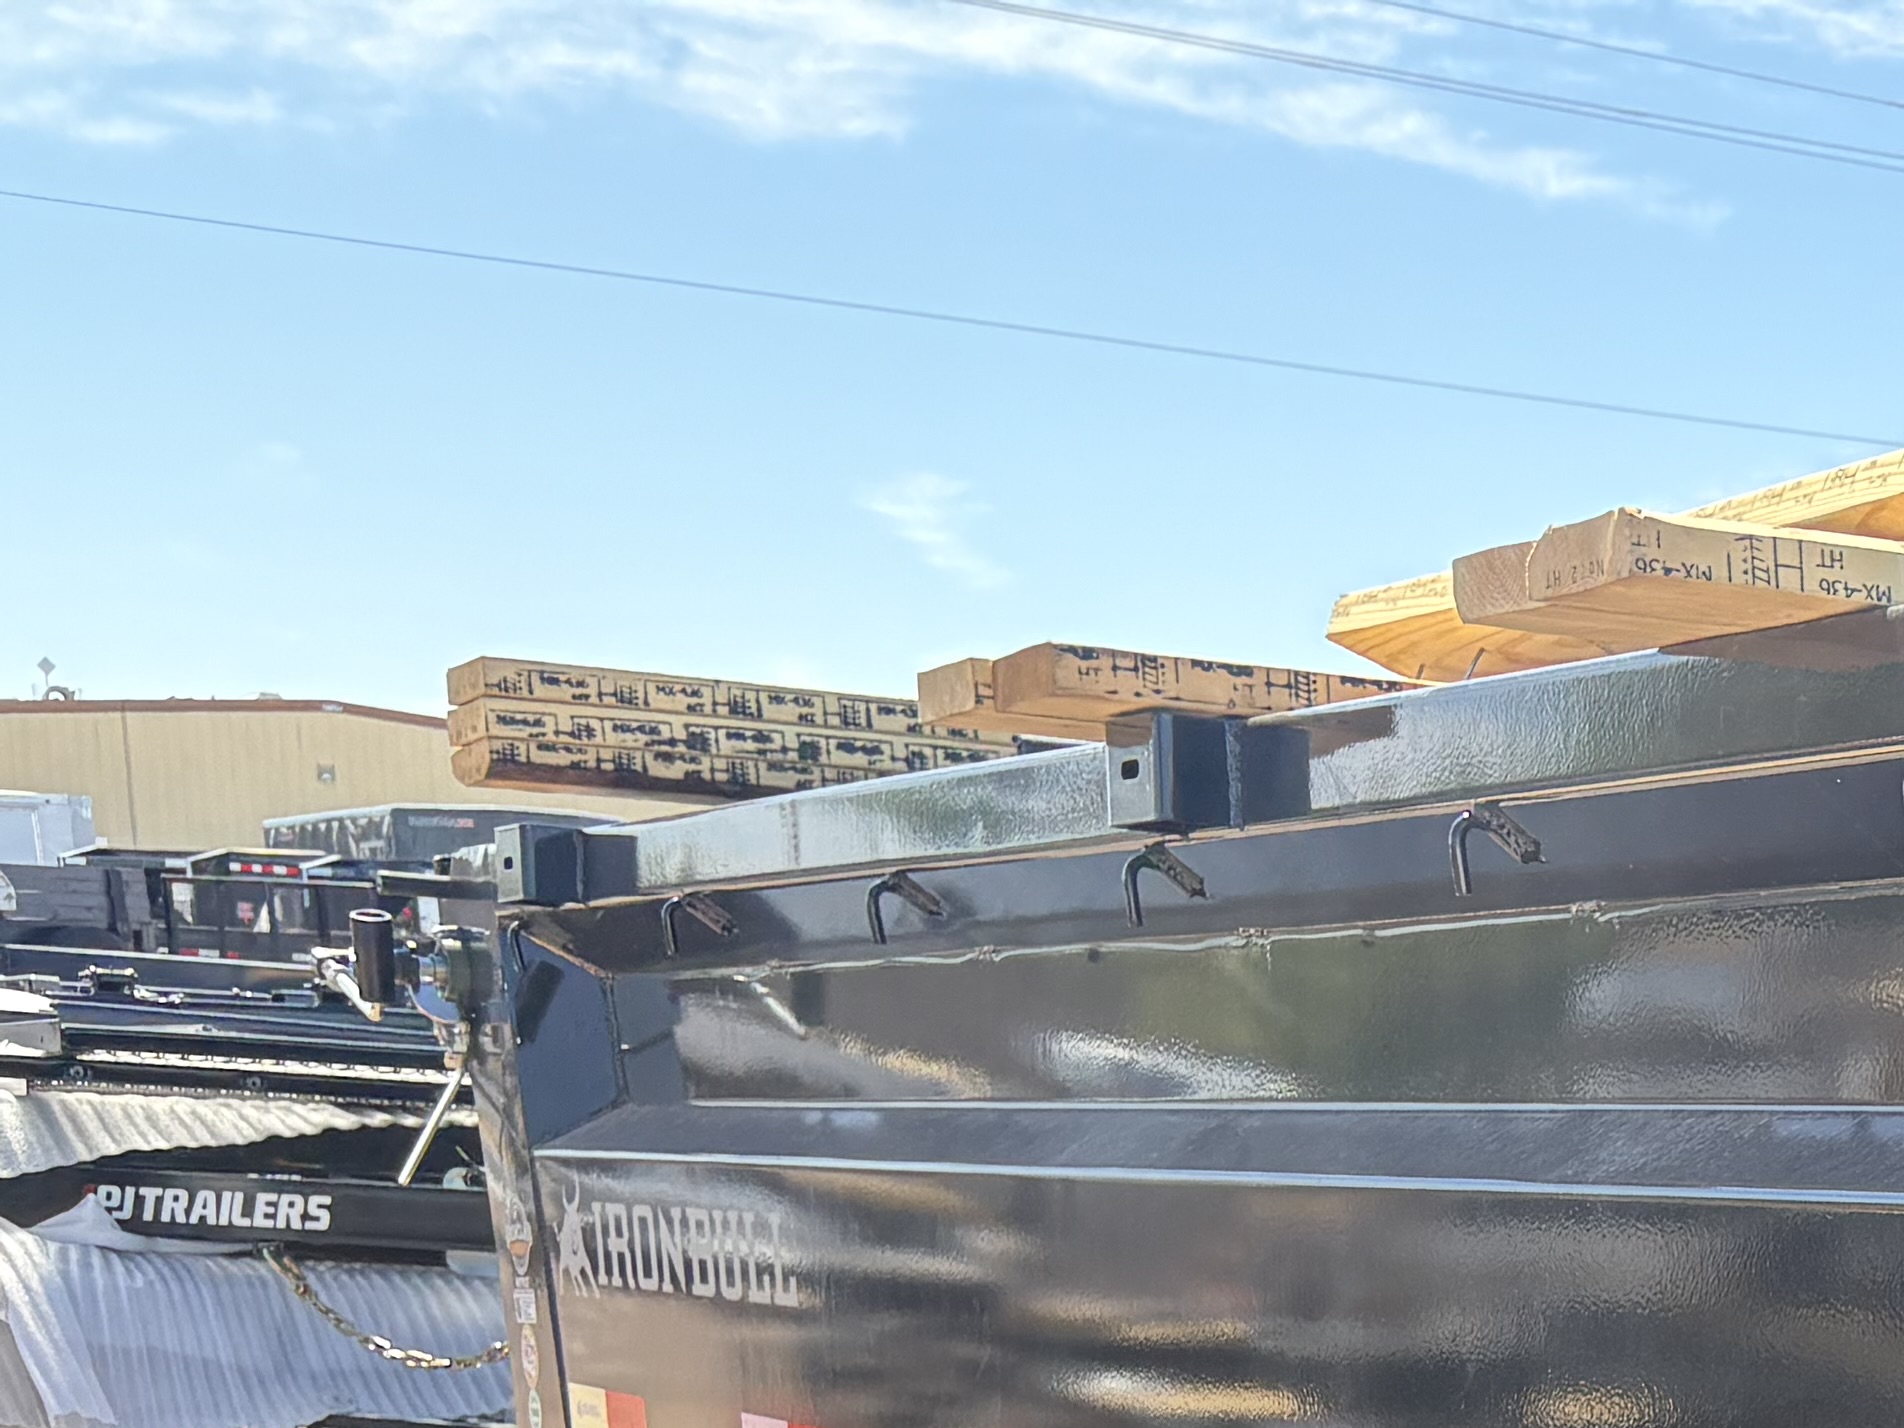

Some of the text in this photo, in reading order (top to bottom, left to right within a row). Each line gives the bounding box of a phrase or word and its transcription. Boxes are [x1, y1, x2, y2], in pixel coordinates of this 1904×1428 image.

[1820, 577, 1892, 603] MX-436
[139, 1187, 333, 1231] TRAILERS
[592, 1202, 799, 1308] IRONBULL
